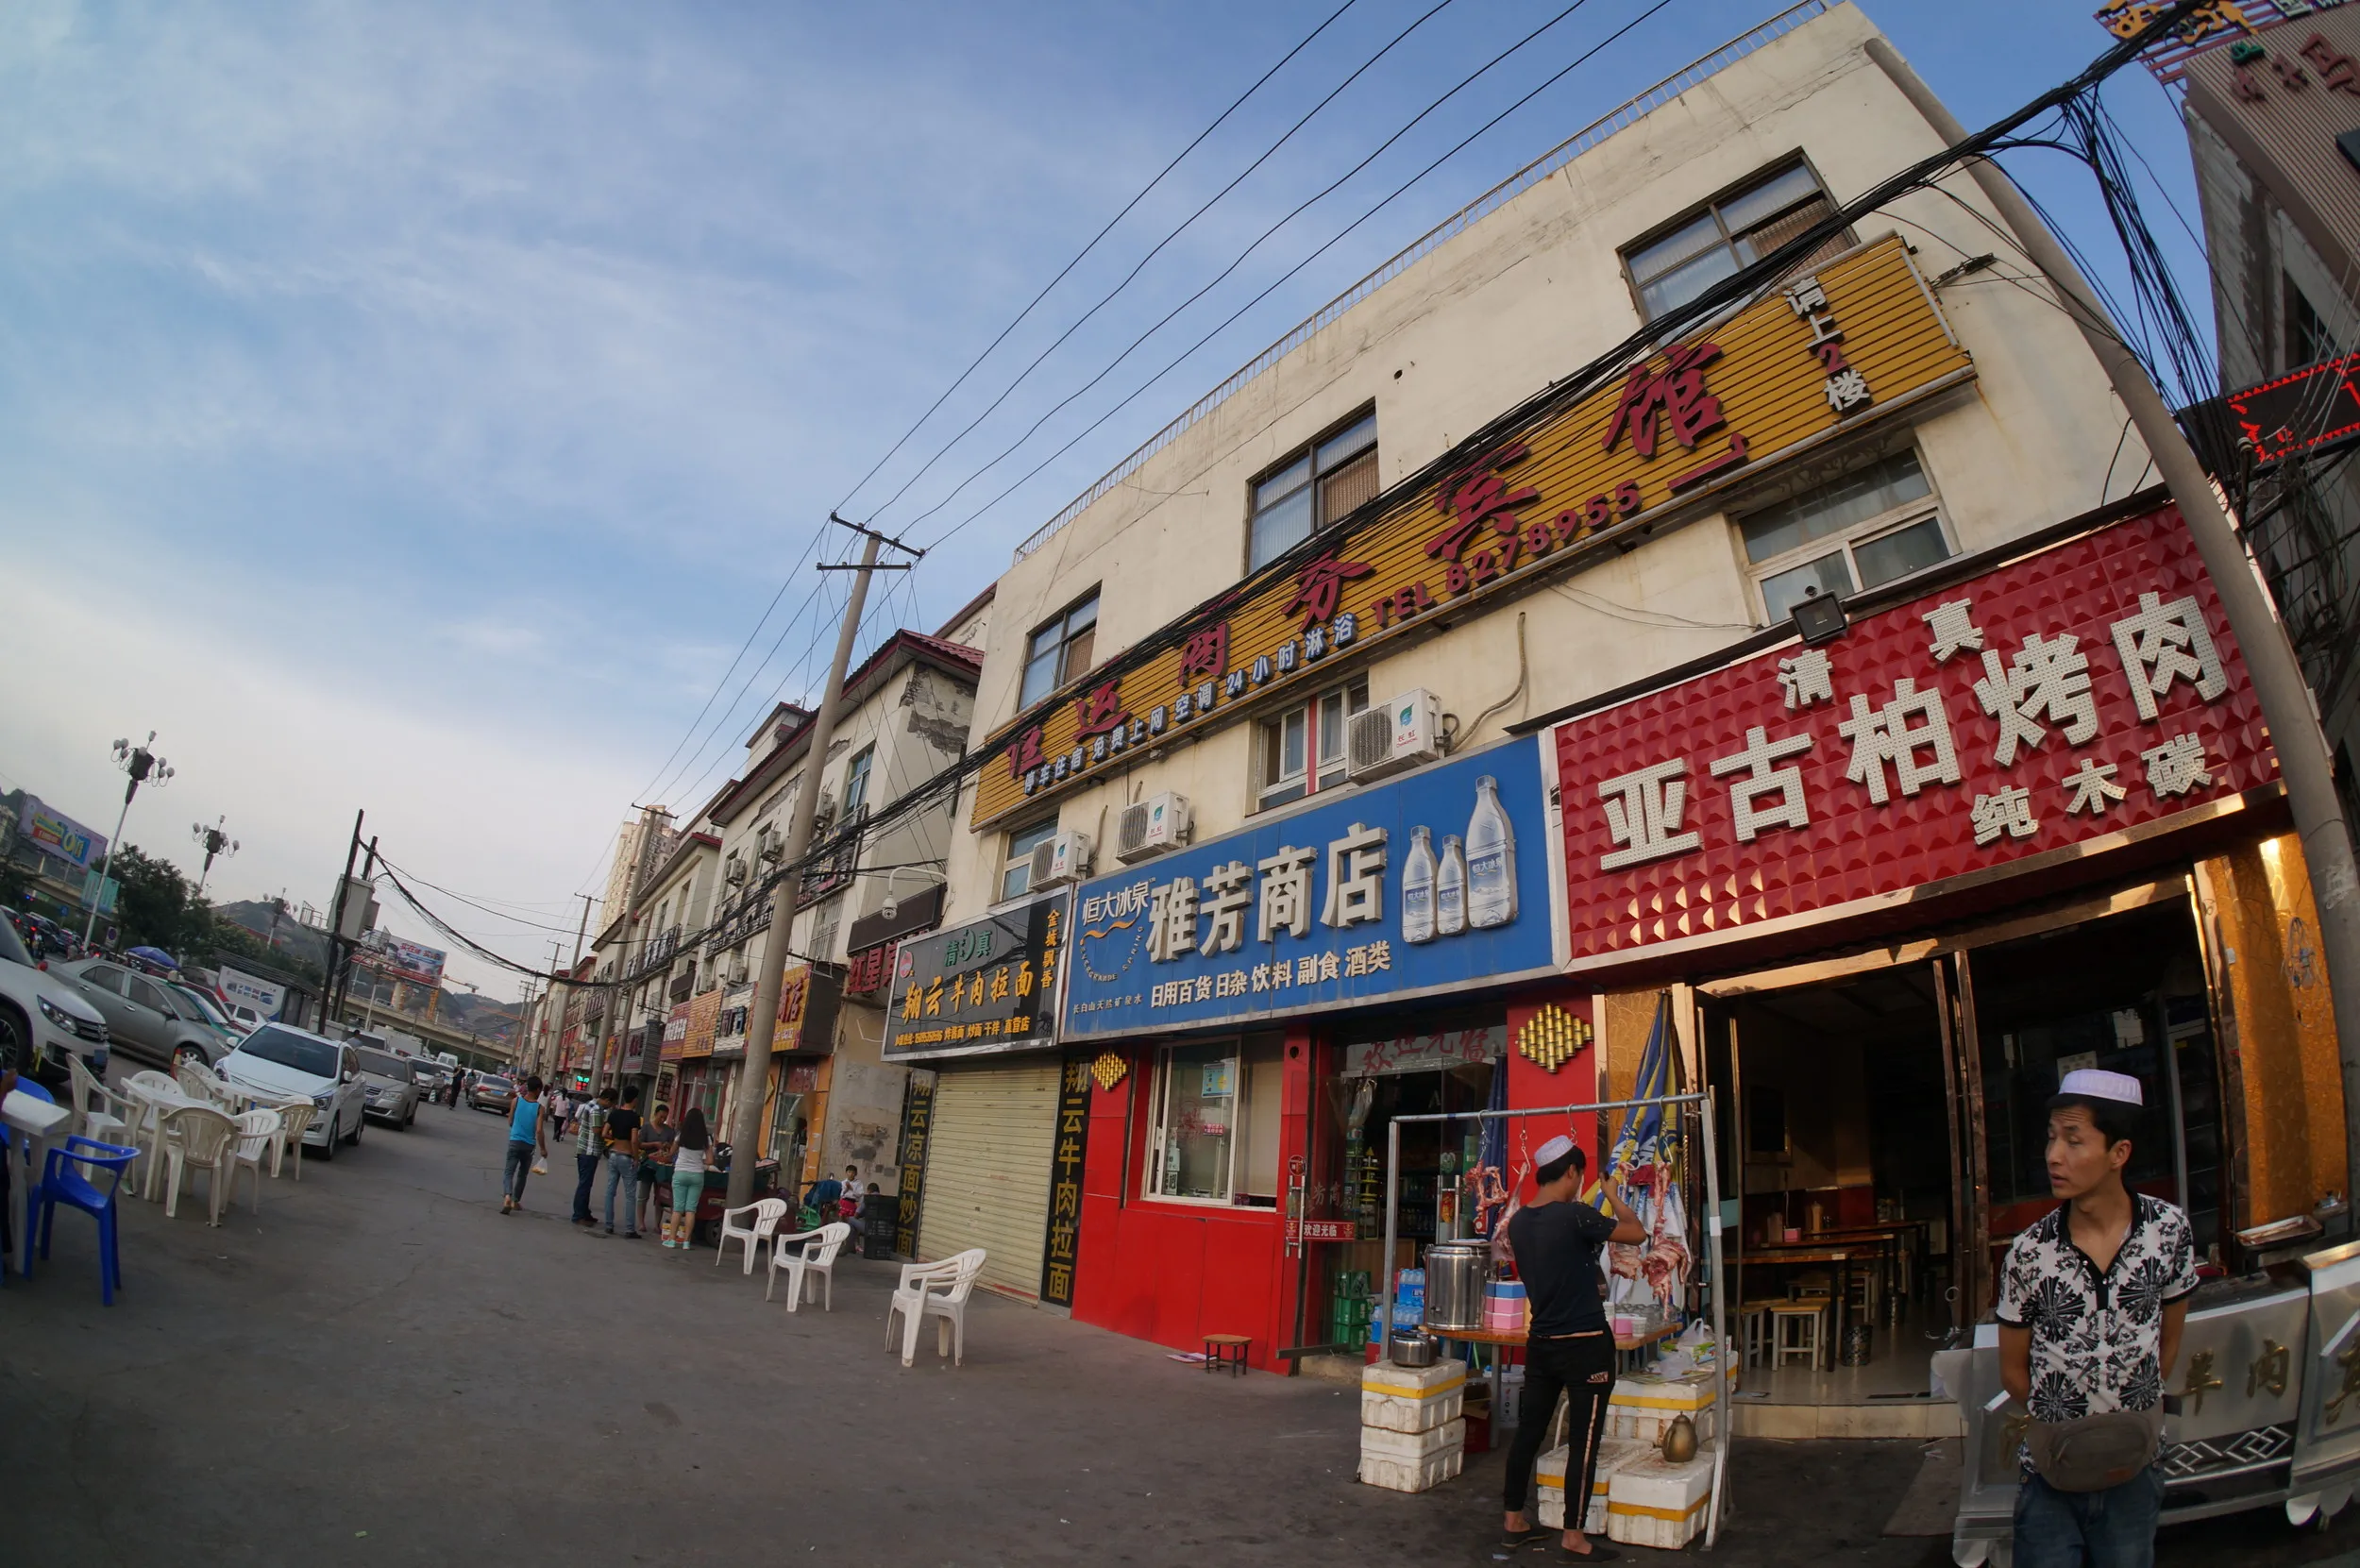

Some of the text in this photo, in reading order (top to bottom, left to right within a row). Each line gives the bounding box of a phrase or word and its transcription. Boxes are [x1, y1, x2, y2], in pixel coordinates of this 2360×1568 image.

[1781, 276, 1871, 412] 请上2楼
[1370, 479, 1643, 627] TEL 8278955
[1776, 597, 1984, 711] 清真
[1024, 745, 1085, 794] 停车住宿
[1092, 705, 1166, 762] 免费上网
[1173, 681, 1213, 721] 空调
[1598, 590, 2229, 872] 亚古柏烤肉
[1970, 732, 2212, 847] 纯木碳
[1040, 909, 1061, 988] 金城飘香
[1082, 880, 1151, 926] 恒大冰泉
[1145, 820, 1389, 964] 雅芳商店
[902, 960, 1033, 1024] 翔云牛肉拉面
[1003, 1016, 1031, 1034] 直营店
[1151, 940, 1391, 1008] 日用百货 日杂 饮料 副食 酒类
[1048, 1063, 1089, 1302] 翔云牛肉拉面
[1304, 1223, 1338, 1237] 欢迎光临
